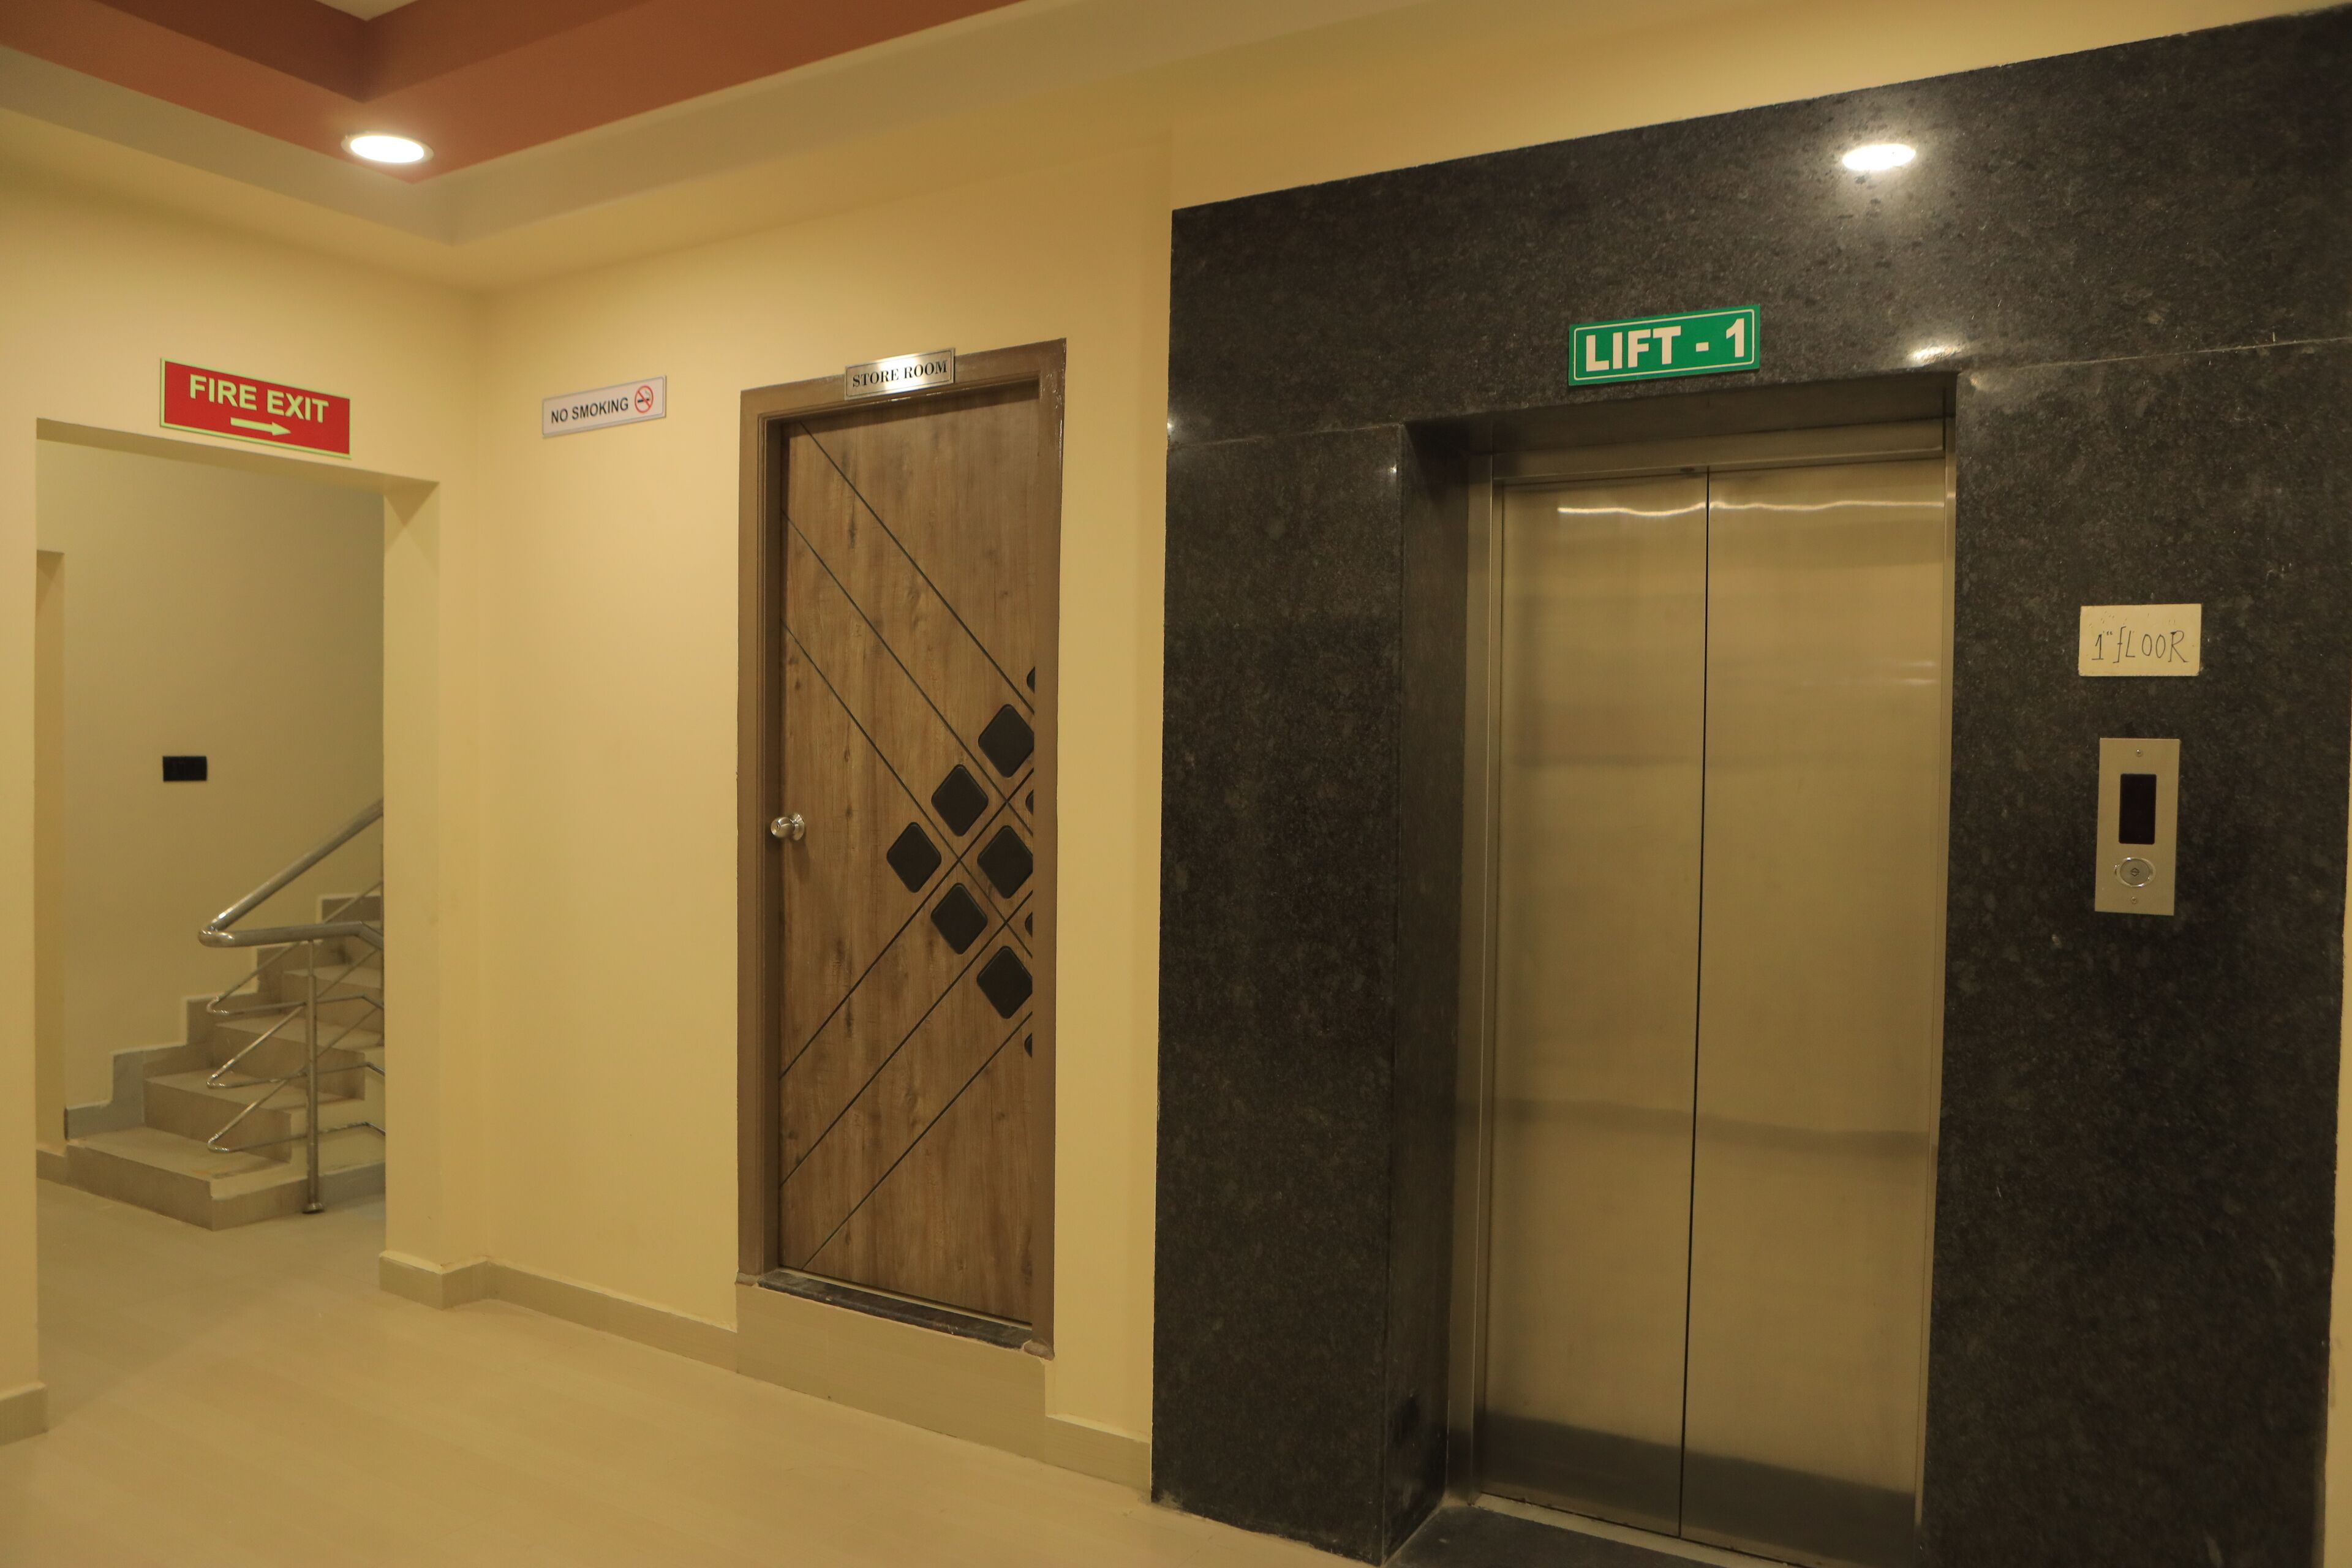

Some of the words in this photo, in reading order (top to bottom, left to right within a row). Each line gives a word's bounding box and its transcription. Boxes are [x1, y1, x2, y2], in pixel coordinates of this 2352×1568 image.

[1586, 325, 1681, 372] LIFT
[1695, 342, 1709, 352] -
[1726, 318, 1744, 358] 1
[853, 369, 899, 387] STORE
[904, 360, 948, 379] ROOM
[190, 374, 257, 410] FIRE
[267, 389, 329, 423] EXIT
[551, 409, 568, 423] NO
[571, 397, 628, 420] SMOKING
